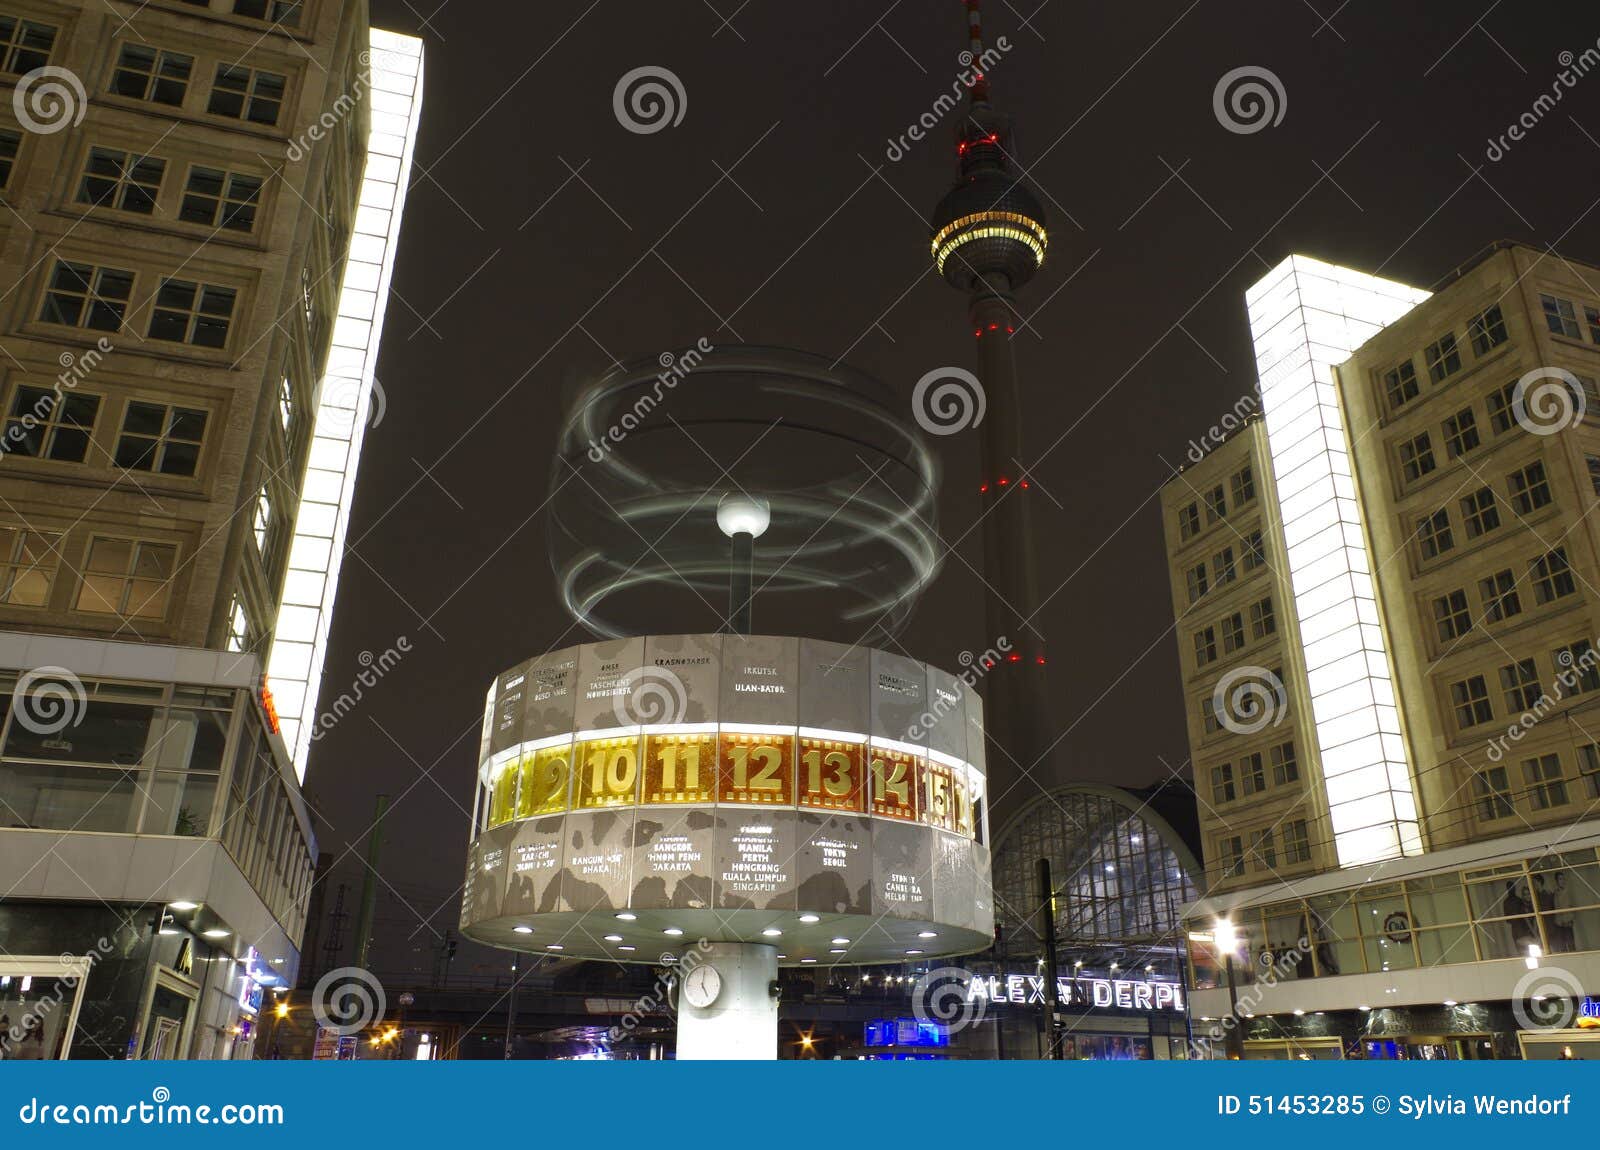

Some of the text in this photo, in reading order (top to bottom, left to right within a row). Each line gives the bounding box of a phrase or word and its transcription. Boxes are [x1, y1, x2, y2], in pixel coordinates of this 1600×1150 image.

[735, 684, 785, 694] ULAN-BATOR
[543, 757, 568, 802] 9
[587, 747, 637, 794] 10
[656, 745, 700, 790] 11
[727, 745, 783, 792] 12
[802, 750, 853, 796] 13
[871, 758, 909, 805] 14
[922, 771, 950, 817] 15
[653, 843, 693, 852] BANGKOK
[738, 843, 774, 853] MANILA
[521, 850, 550, 862] KARCHI
[678, 851, 701, 861] PENH
[742, 853, 769, 863] PERTH
[823, 848, 847, 858] TOKYO
[653, 862, 692, 872] JAKARTA
[823, 858, 847, 867] SEOUL
[731, 863, 780, 873] HONGKONG
[722, 872, 787, 882] KUALA LUMPUR
[891, 873, 916, 884] SYDNY
[733, 883, 776, 892] SINGAPUR
[886, 883, 922, 895] CANBERA
[884, 892, 923, 903] MELBORNE
